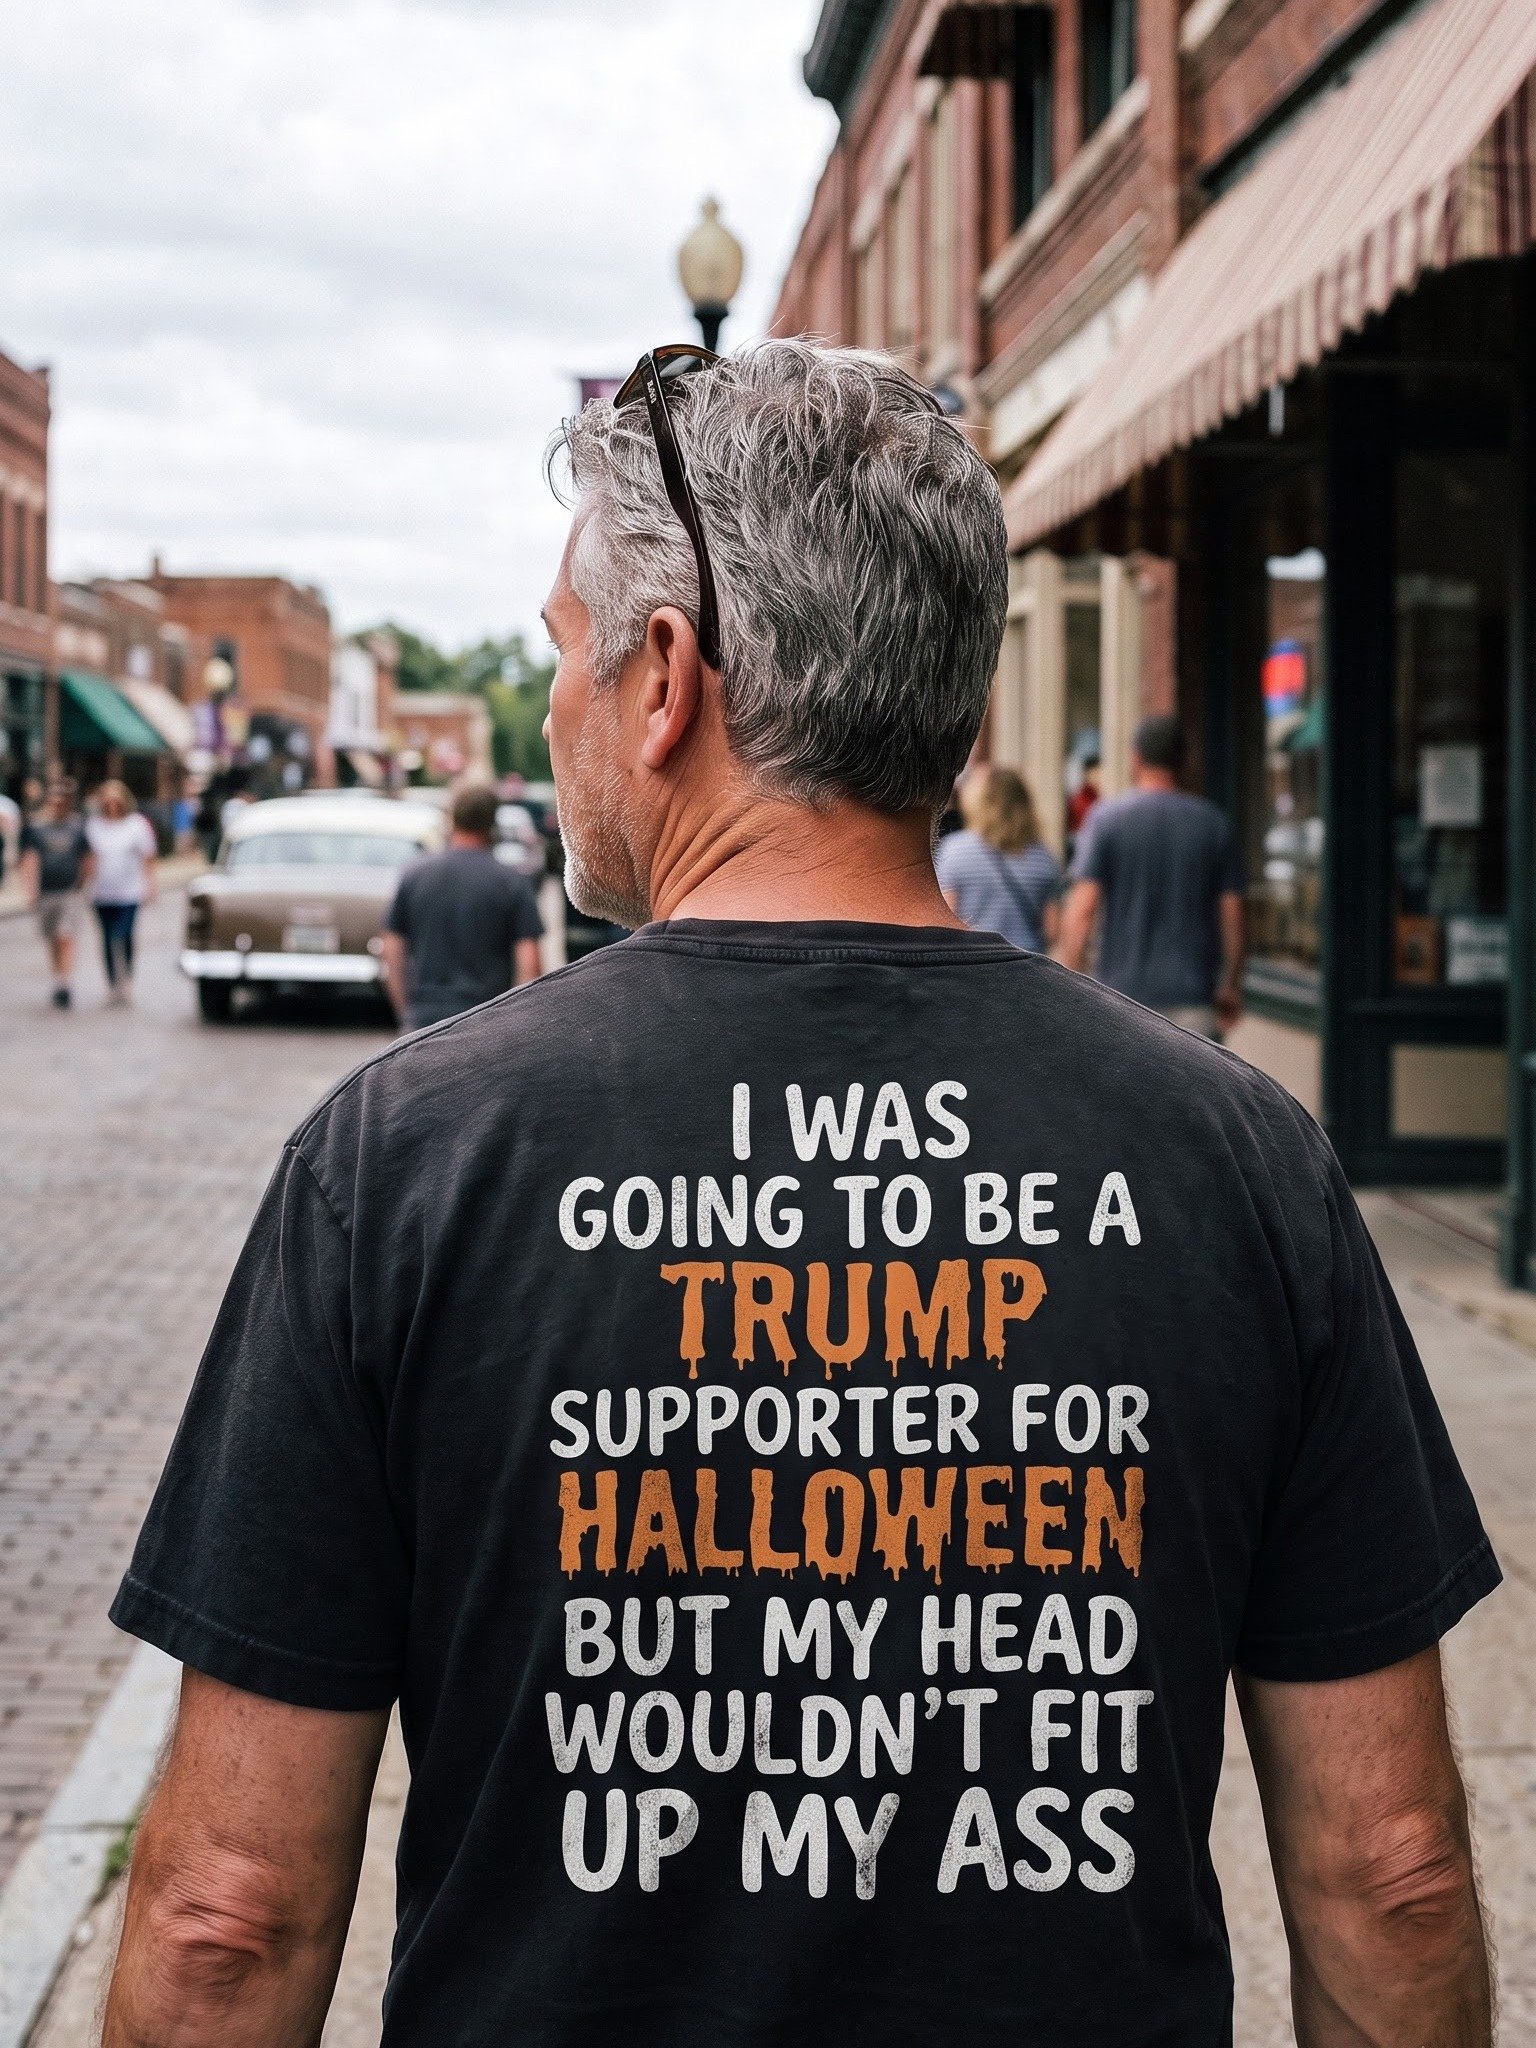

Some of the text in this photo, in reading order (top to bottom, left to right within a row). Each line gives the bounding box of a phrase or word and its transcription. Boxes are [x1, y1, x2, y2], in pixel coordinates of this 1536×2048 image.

[733, 1081, 970, 1161] I WAS
[559, 1172, 1141, 1250] GOING TO BE A
[660, 1259, 1048, 1380] TRUMP
[550, 1384, 1150, 1458] SUPPORTER FOR
[559, 1466, 1145, 1585] HALLOWEEN
[564, 1593, 1138, 1680] BUT MY HEAD
[545, 1687, 1155, 1778] WOULDN’T FIT
[562, 1786, 1136, 1900] UP MY ASS
